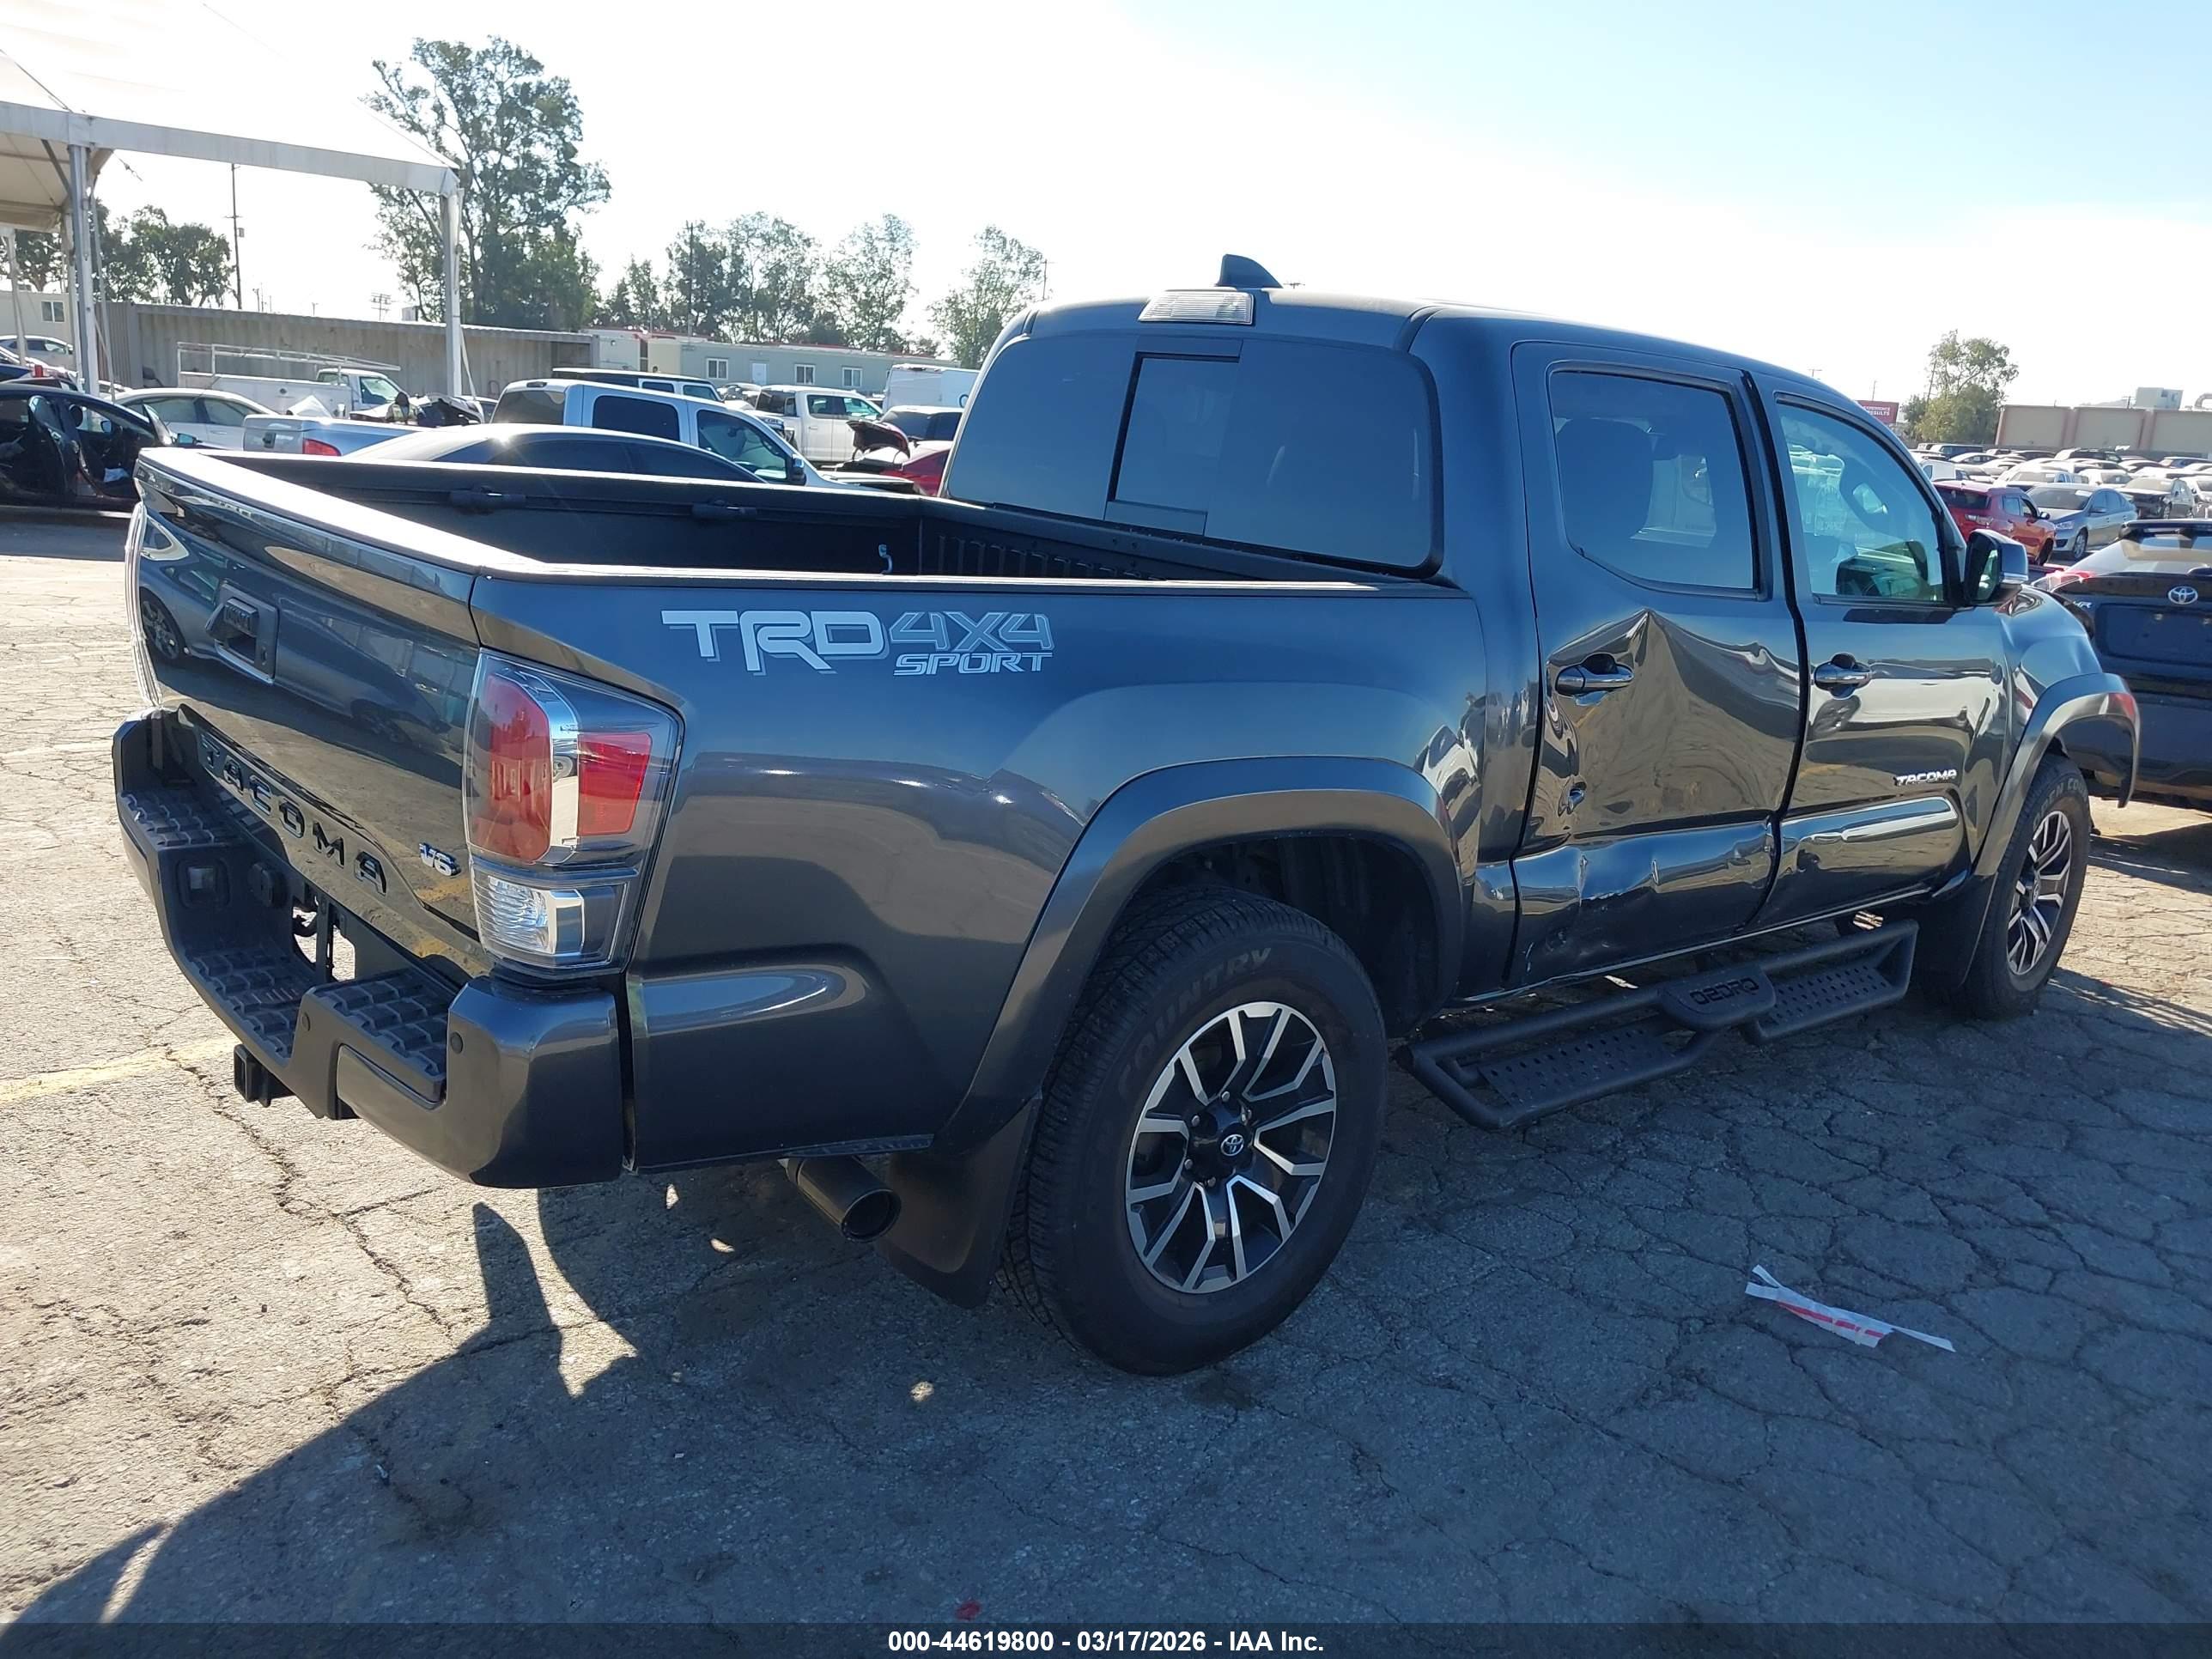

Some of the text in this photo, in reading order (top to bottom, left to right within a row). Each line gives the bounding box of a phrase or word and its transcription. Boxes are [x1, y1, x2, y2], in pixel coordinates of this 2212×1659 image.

[661, 610, 888, 676] TRD
[893, 651, 1054, 677] SPORT
[1895, 769, 1958, 787] TACOMA
[200, 732, 387, 896] TACOMA
[418, 842, 462, 878] V6
